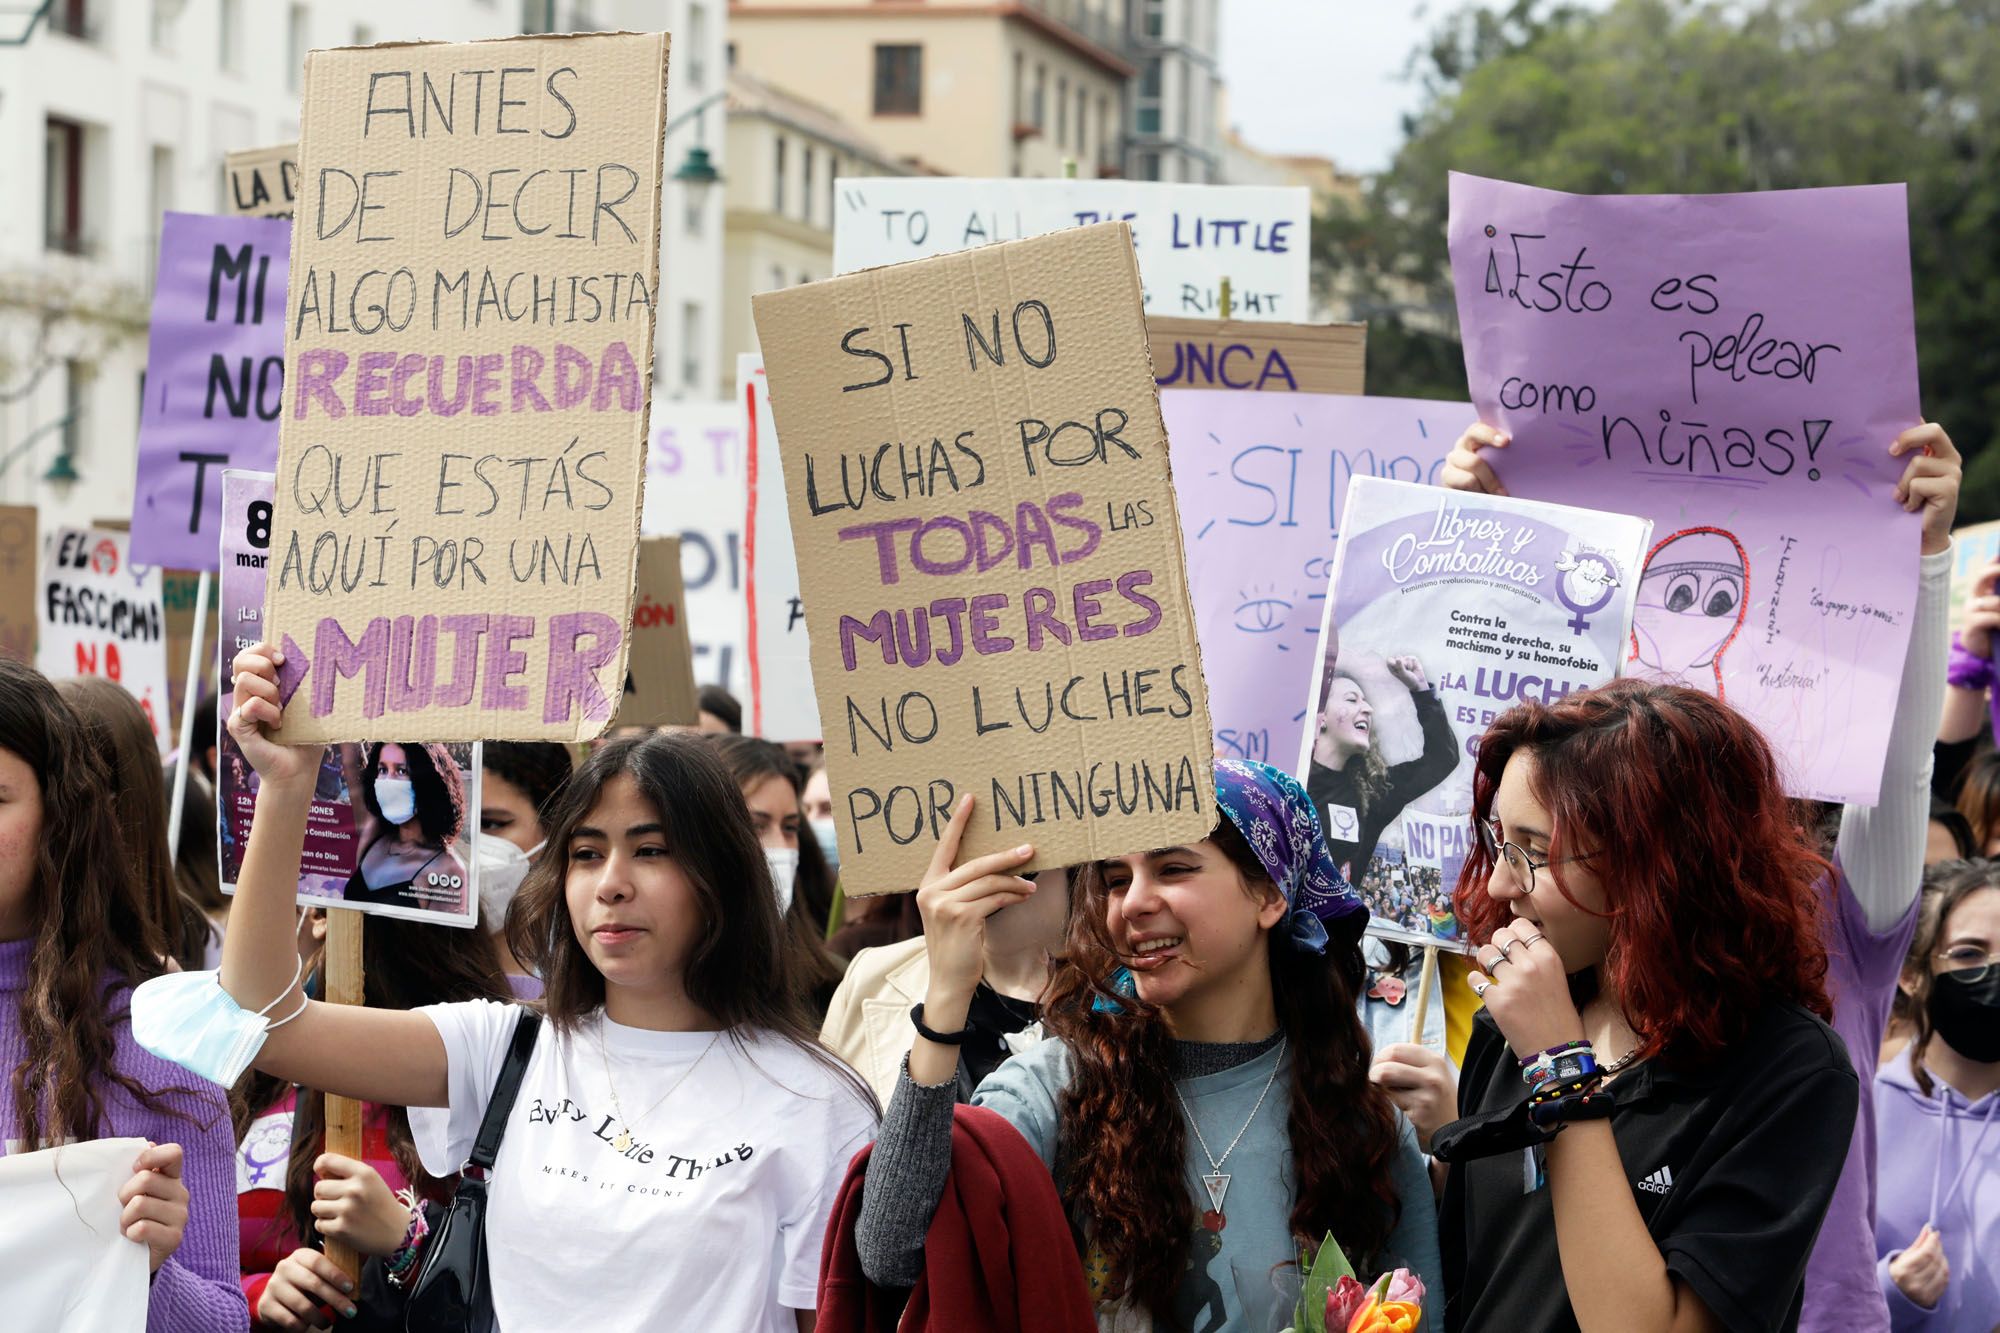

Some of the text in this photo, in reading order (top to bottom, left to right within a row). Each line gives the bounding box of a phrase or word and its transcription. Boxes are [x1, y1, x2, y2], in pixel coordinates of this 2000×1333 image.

[364, 67, 578, 138] ANTES
[231, 168, 270, 209] LA
[316, 163, 640, 246] DE DECIR
[1172, 212, 1294, 253] LITTLE
[206, 244, 270, 325] MI
[295, 266, 653, 340] ALGO MACHISTA
[1485, 224, 1719, 314] ¡Esto es
[294, 342, 645, 421] RECUERDA
[841, 300, 1057, 392] SI NO
[1679, 313, 1842, 404] pelear
[805, 408, 1142, 517] LUCHAS POR
[1500, 377, 1832, 481] como niñas!
[293, 436, 614, 520] QUE ESTÁS
[1227, 445, 1302, 526] SI
[246, 500, 273, 549] 8
[278, 518, 399, 596] AQUÍ
[411, 537, 487, 591] POR
[508, 533, 602, 586] UNA
[838, 492, 1154, 586] TODAS LAS
[1382, 534, 1545, 586] Combativas
[1416, 496, 1536, 554] Libres y
[838, 570, 1162, 671] MUJERES
[1401, 580, 1438, 595] Feminismo
[1439, 576, 1489, 586] revolucionario
[1495, 582, 1541, 605] anticapitalista
[1451, 610, 1507, 629] Contra la
[76, 642, 121, 683] NO
[310, 612, 623, 725] MUJER
[1446, 638, 1599, 671] machismo y su homofobia
[1448, 626, 1571, 653] extrema derecha, su
[846, 664, 1193, 756] NO LUCHES
[1439, 667, 1590, 705] ¡LA LUCH
[1456, 706, 1476, 724] ES
[237, 796, 251, 806] 12h
[309, 828, 351, 840] Constitución
[847, 755, 1200, 854] POR NINGUNA
[315, 851, 323, 859] de
[324, 853, 339, 861] Dios
[1407, 822, 1435, 860] NO
[541, 1165, 588, 1182] MKES
